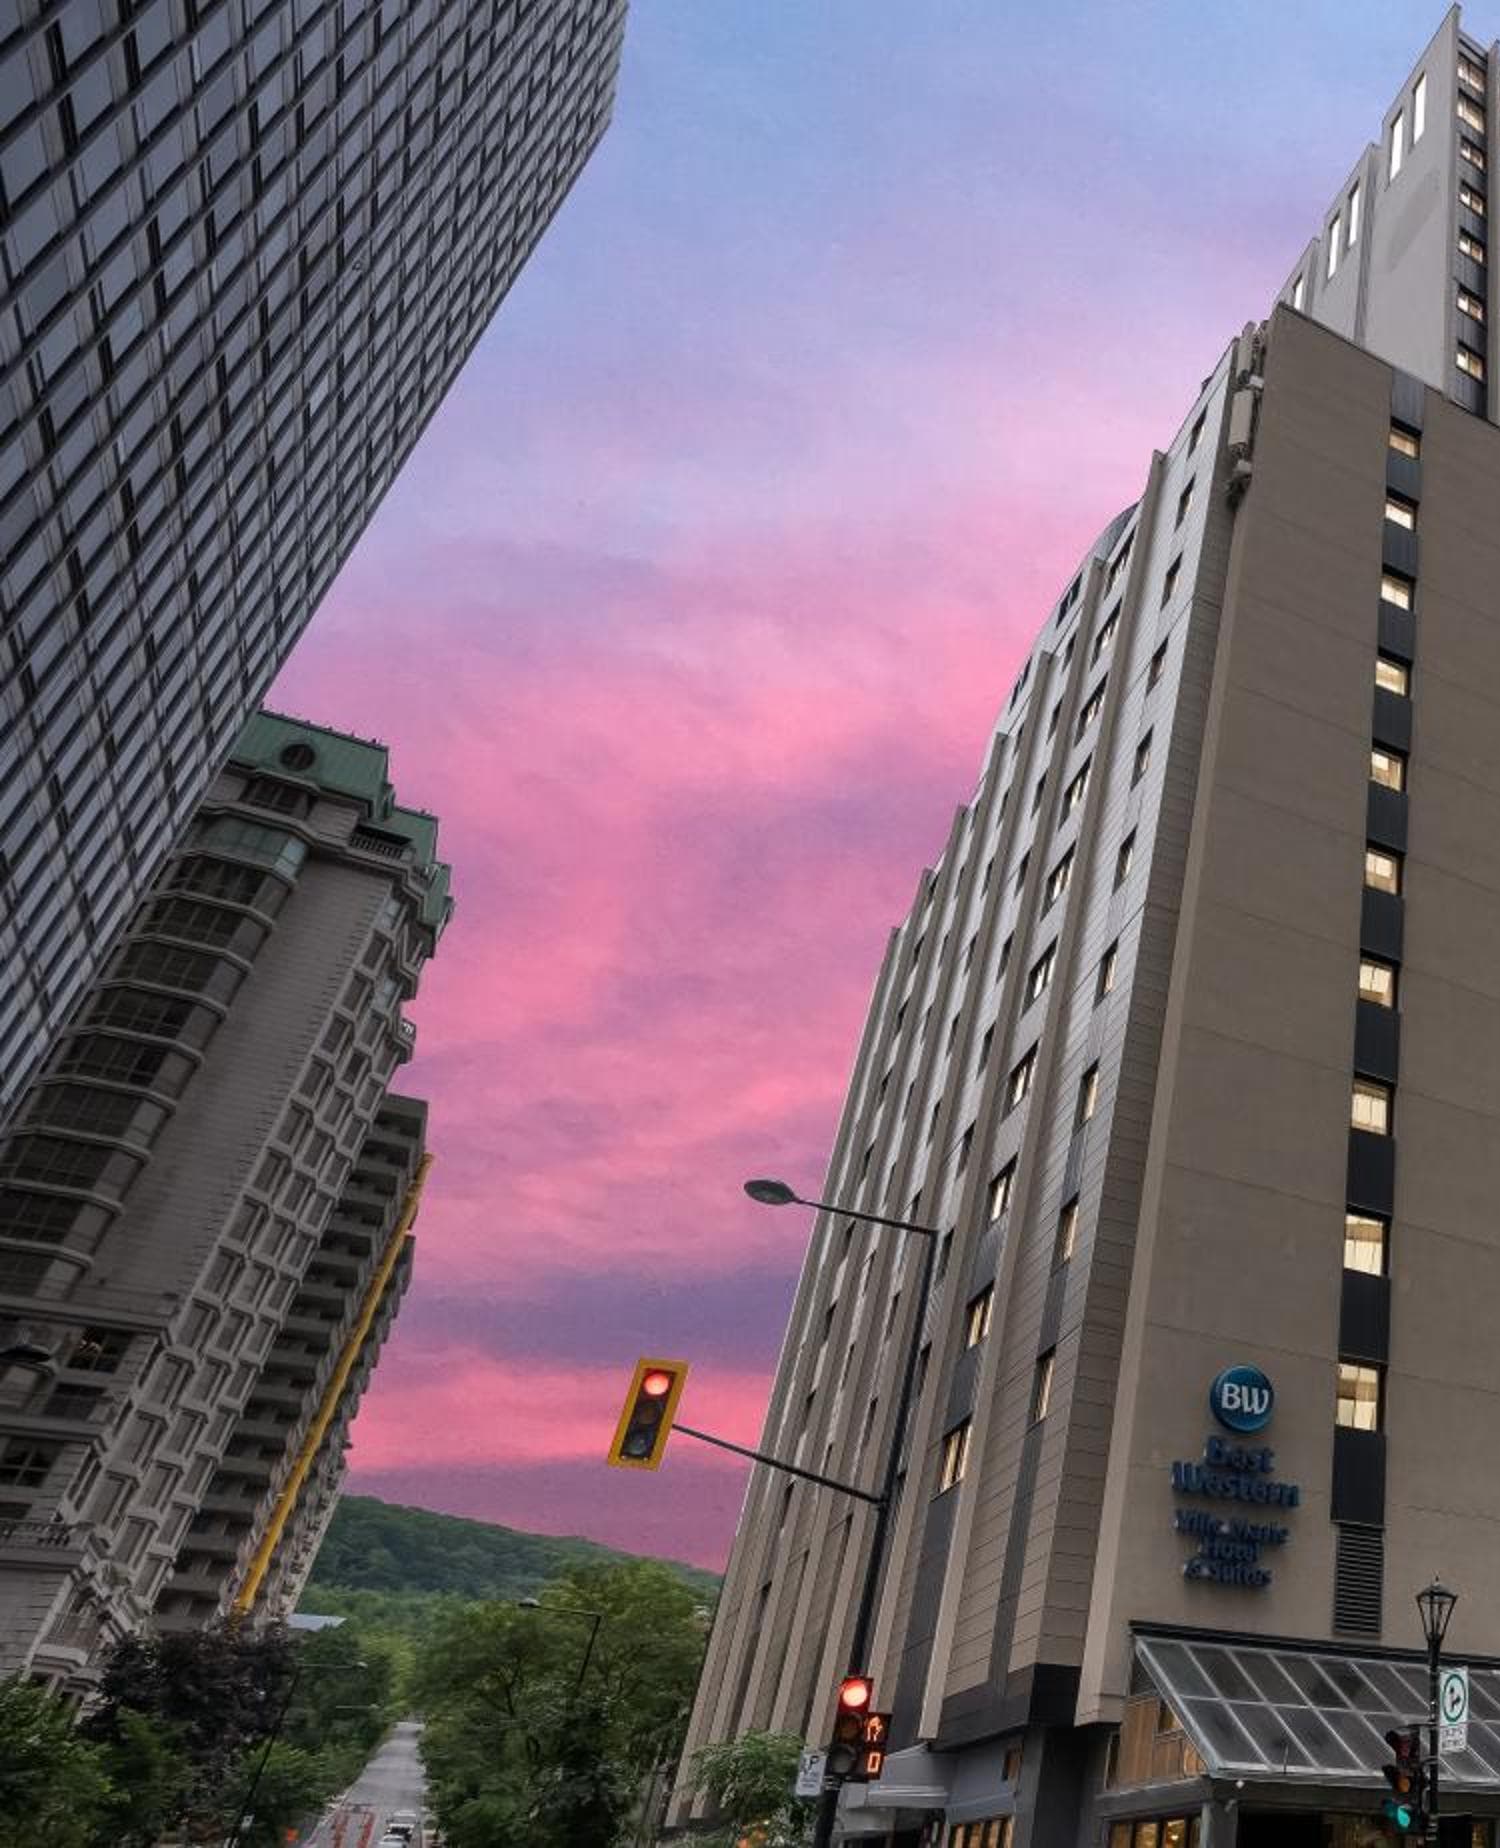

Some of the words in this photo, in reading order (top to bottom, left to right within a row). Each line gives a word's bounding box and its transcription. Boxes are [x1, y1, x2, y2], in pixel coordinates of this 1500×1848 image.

[1220, 1382, 1270, 1415] BW
[1203, 1435, 1274, 1474] Best
[1171, 1460, 1300, 1508] Western
